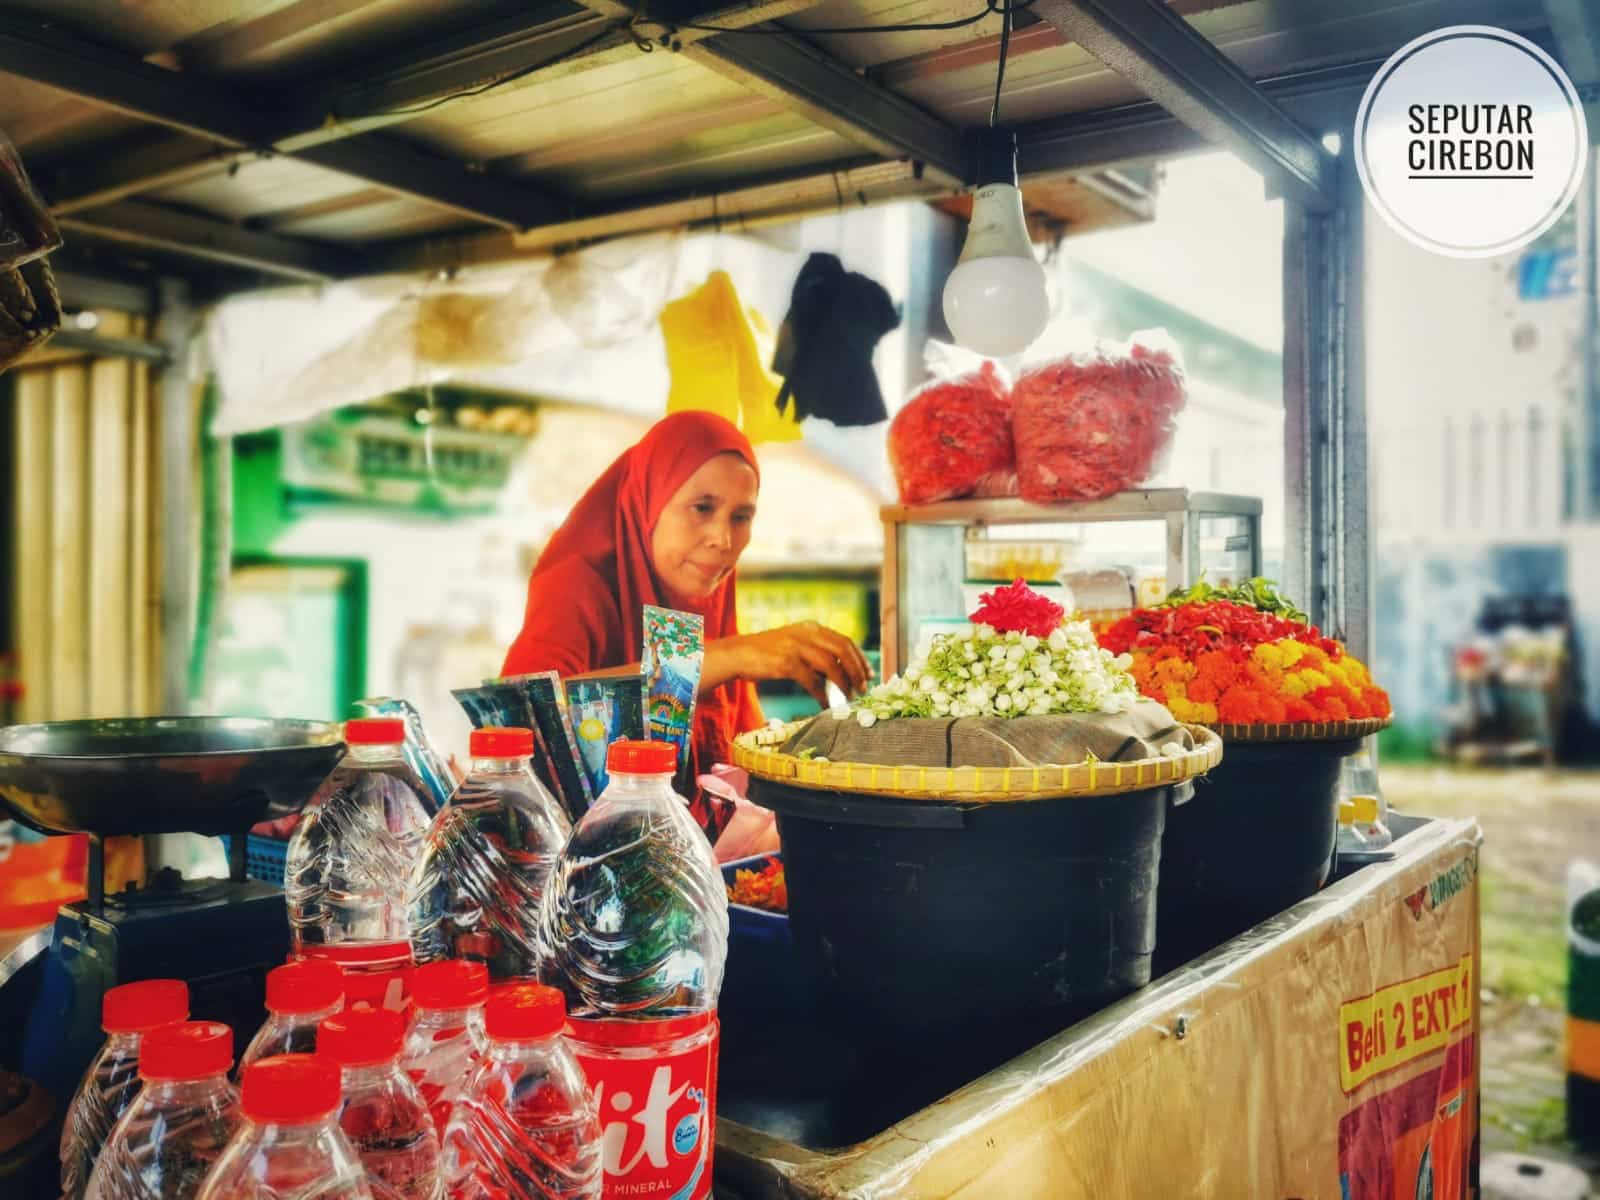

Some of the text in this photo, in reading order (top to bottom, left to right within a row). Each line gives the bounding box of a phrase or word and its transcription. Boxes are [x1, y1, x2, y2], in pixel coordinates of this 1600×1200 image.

[1347, 1008, 1386, 1073] Beli
[1393, 1001, 1406, 1051] 2
[615, 1179, 672, 1194] MINERAL
